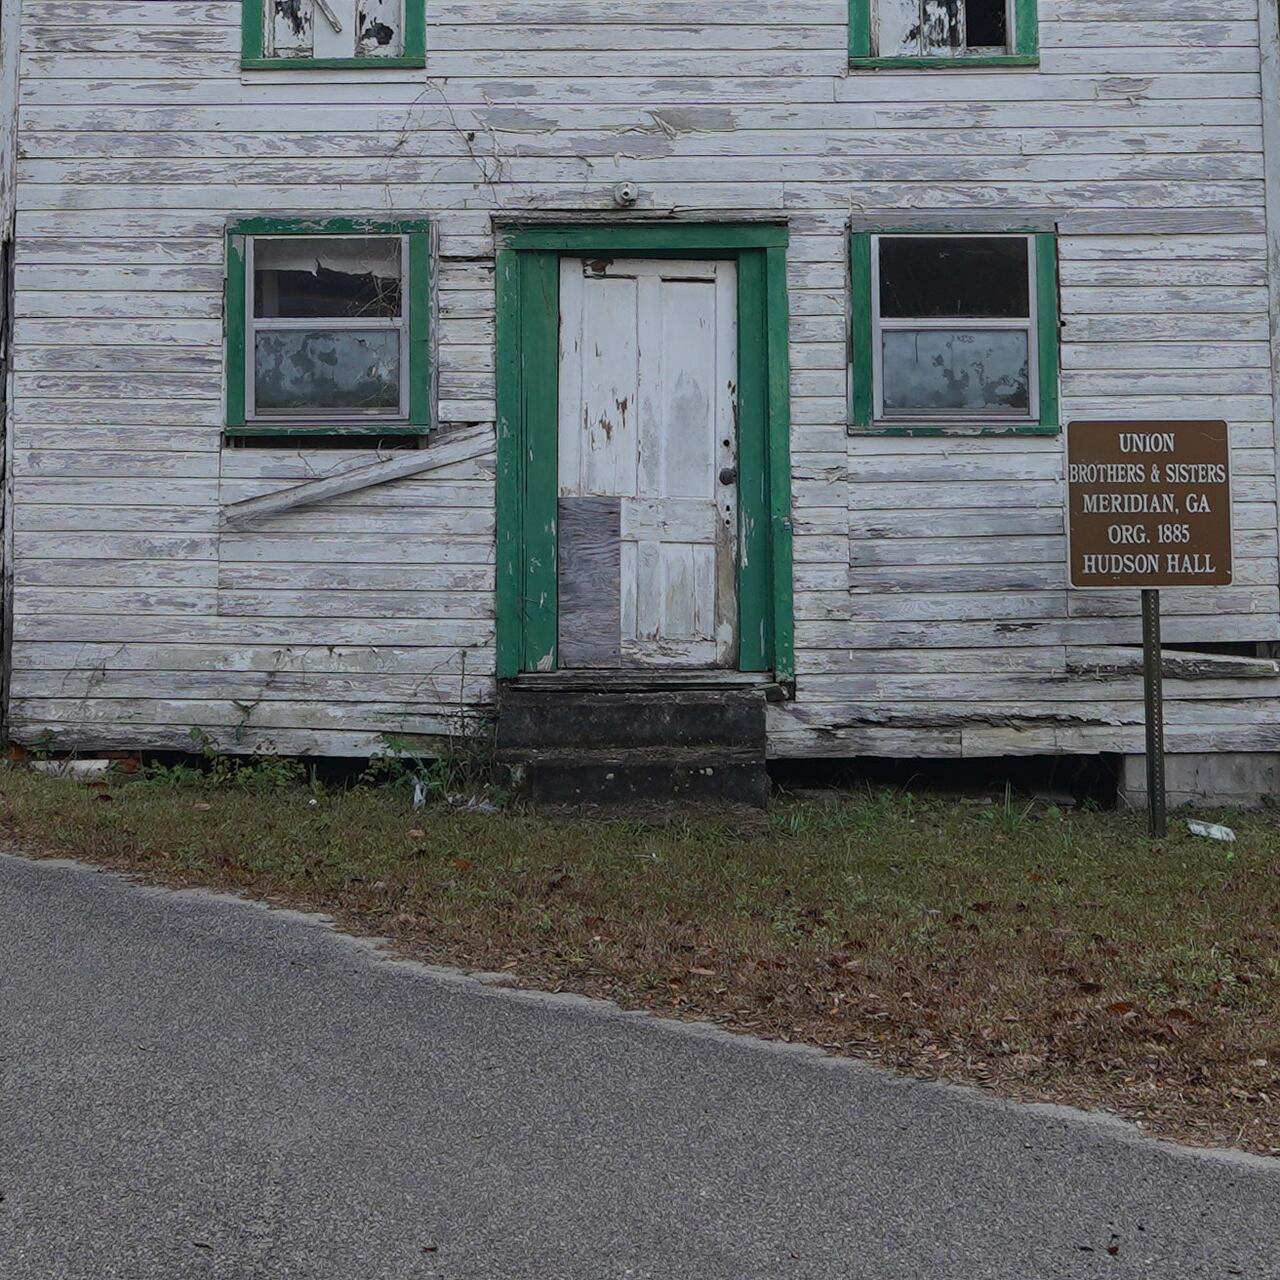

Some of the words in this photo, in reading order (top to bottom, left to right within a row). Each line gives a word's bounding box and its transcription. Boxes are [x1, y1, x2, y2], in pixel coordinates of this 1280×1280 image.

[1119, 433, 1175, 452] UNION
[1070, 464, 1145, 483] BROTHERS
[1150, 464, 1160, 483] &
[1166, 464, 1226, 483] SISTERS
[1083, 494, 1179, 514] MERIDIAN,
[1186, 494, 1211, 513] GA
[1108, 525, 1151, 544] ORG.
[1158, 524, 1190, 544] 1885
[1083, 554, 1159, 574] HUDSON
[1167, 554, 1216, 574] HALL
